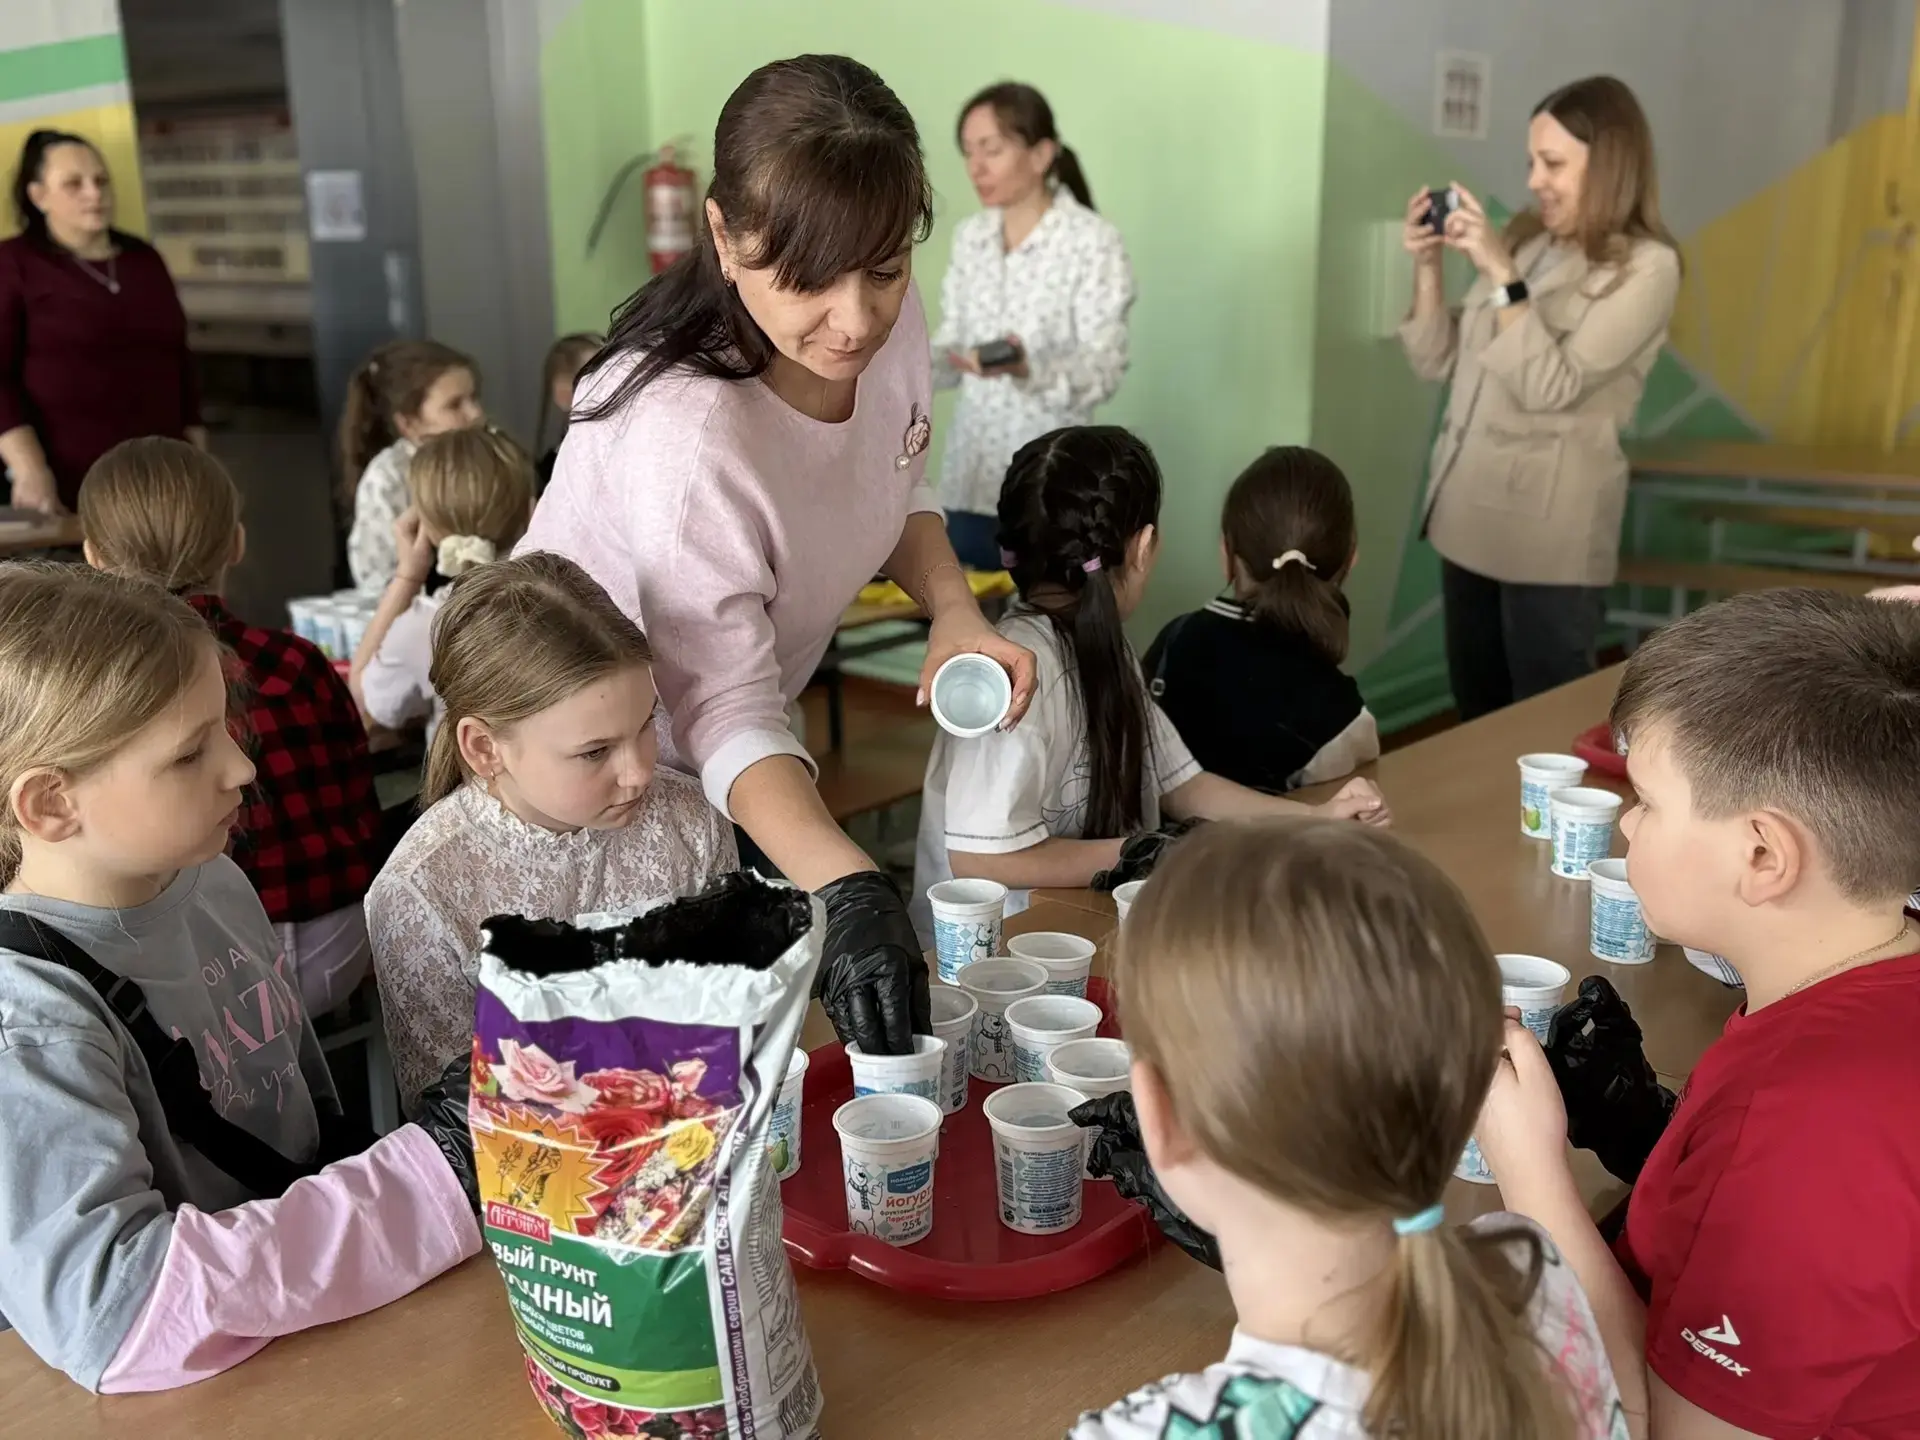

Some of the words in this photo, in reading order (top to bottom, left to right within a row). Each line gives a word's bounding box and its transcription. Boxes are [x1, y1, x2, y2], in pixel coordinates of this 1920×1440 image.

[202, 957, 226, 987] OU
[228, 947, 252, 970] A
[491, 1241, 535, 1270] ВЫЙ
[540, 1254, 598, 1288] ГРУНТ
[719, 1253, 735, 1287] САМ
[725, 1289, 742, 1329] серии
[545, 1328, 594, 1355] РАСТЕНИЙ
[1681, 1328, 1751, 1377] DEMIX
[568, 1365, 613, 1389] ПРОДУКТ
[731, 1332, 753, 1411] удобрениями
